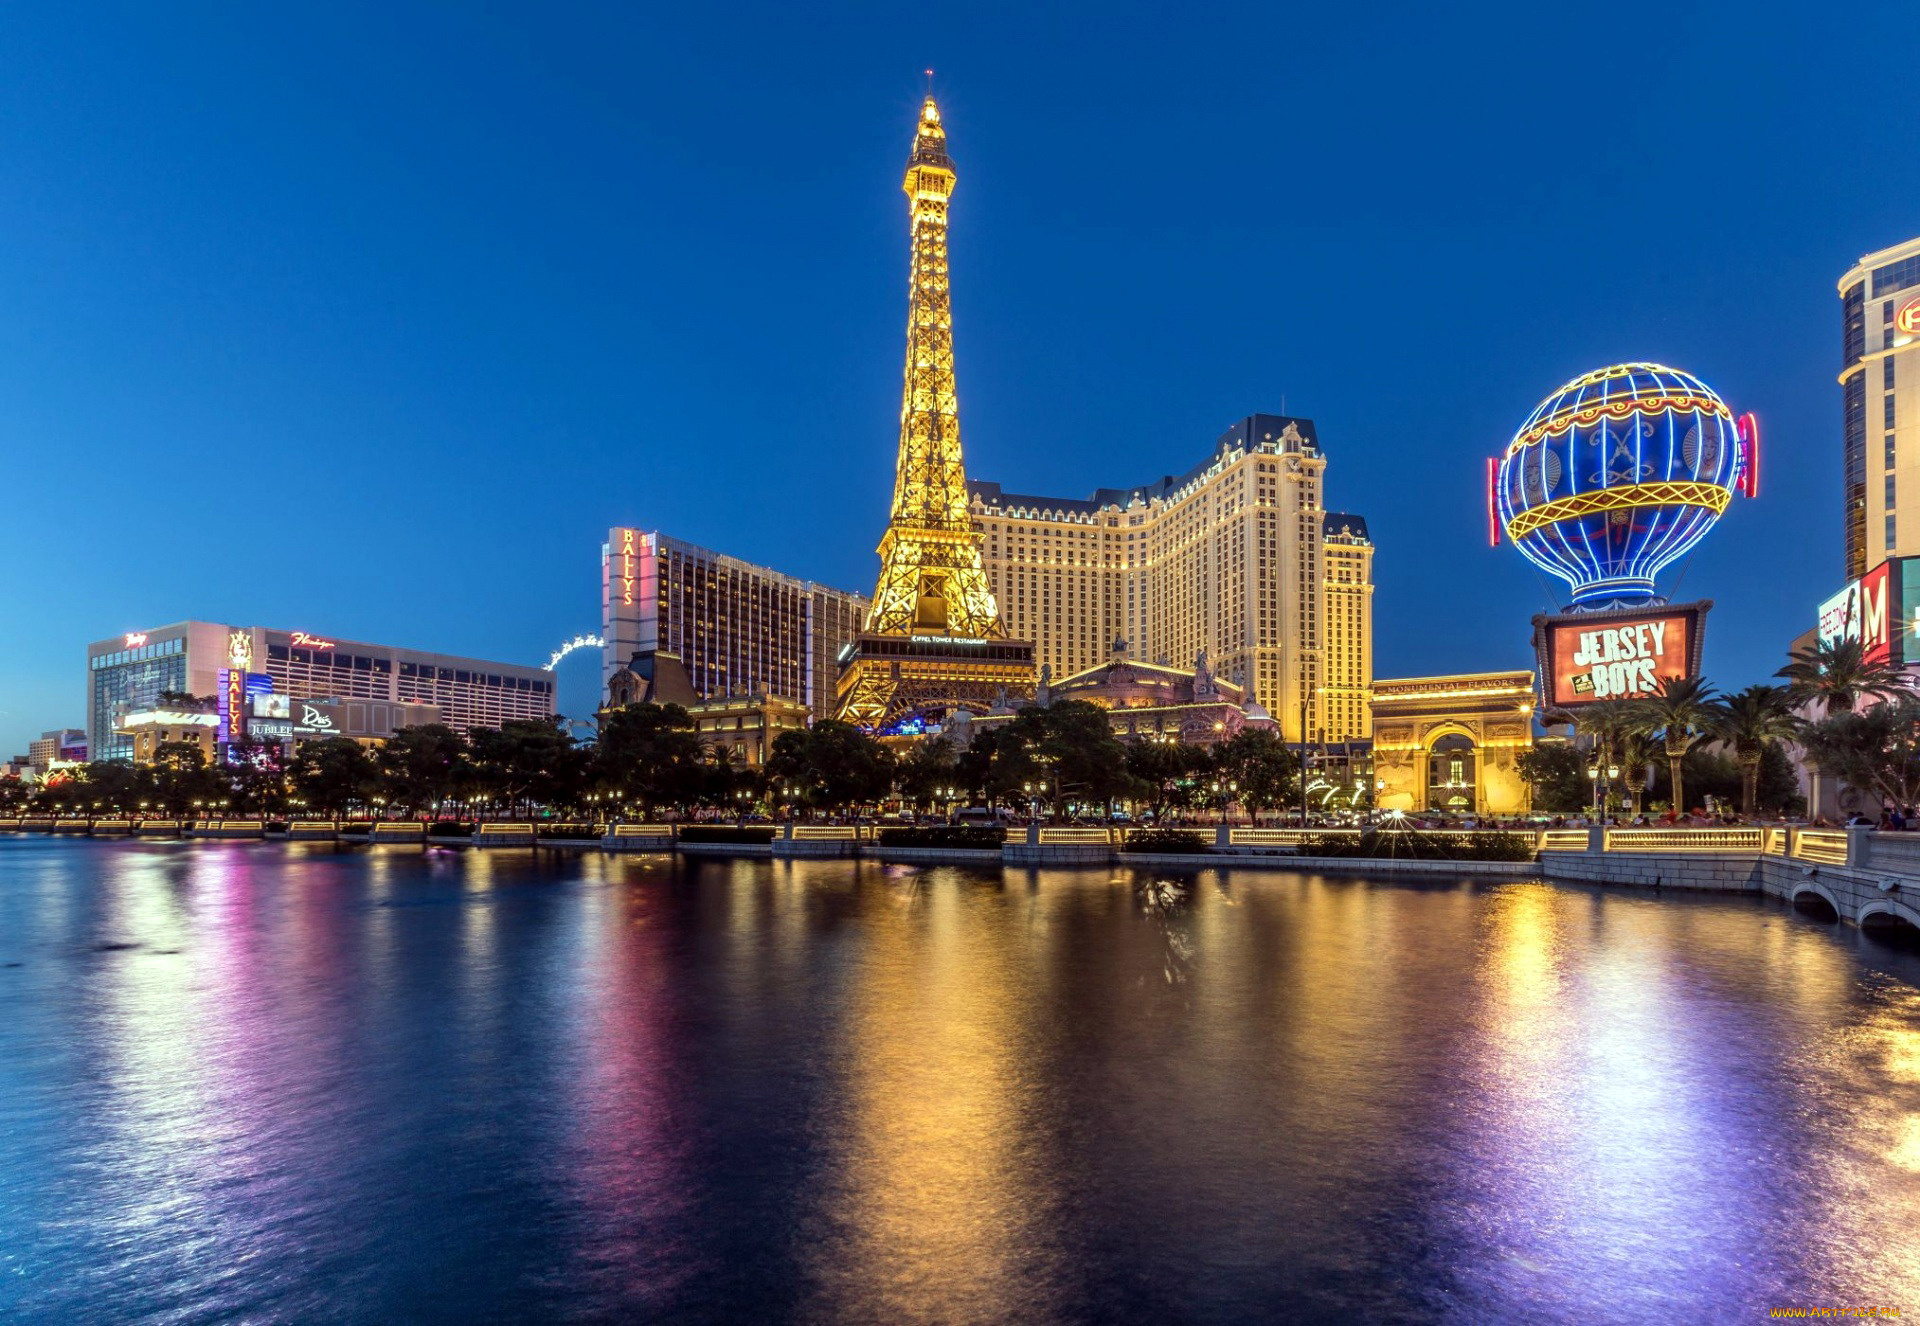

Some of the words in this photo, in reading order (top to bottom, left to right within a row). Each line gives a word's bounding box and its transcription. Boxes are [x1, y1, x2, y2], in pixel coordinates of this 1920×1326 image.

[1573, 621, 1666, 666] JERSEY
[1387, 682, 1461, 693] MONUMENTAL
[1468, 679, 1515, 689] FLAVORS
[1591, 658, 1658, 698] BOYS
[252, 724, 293, 736] JUBILEE
